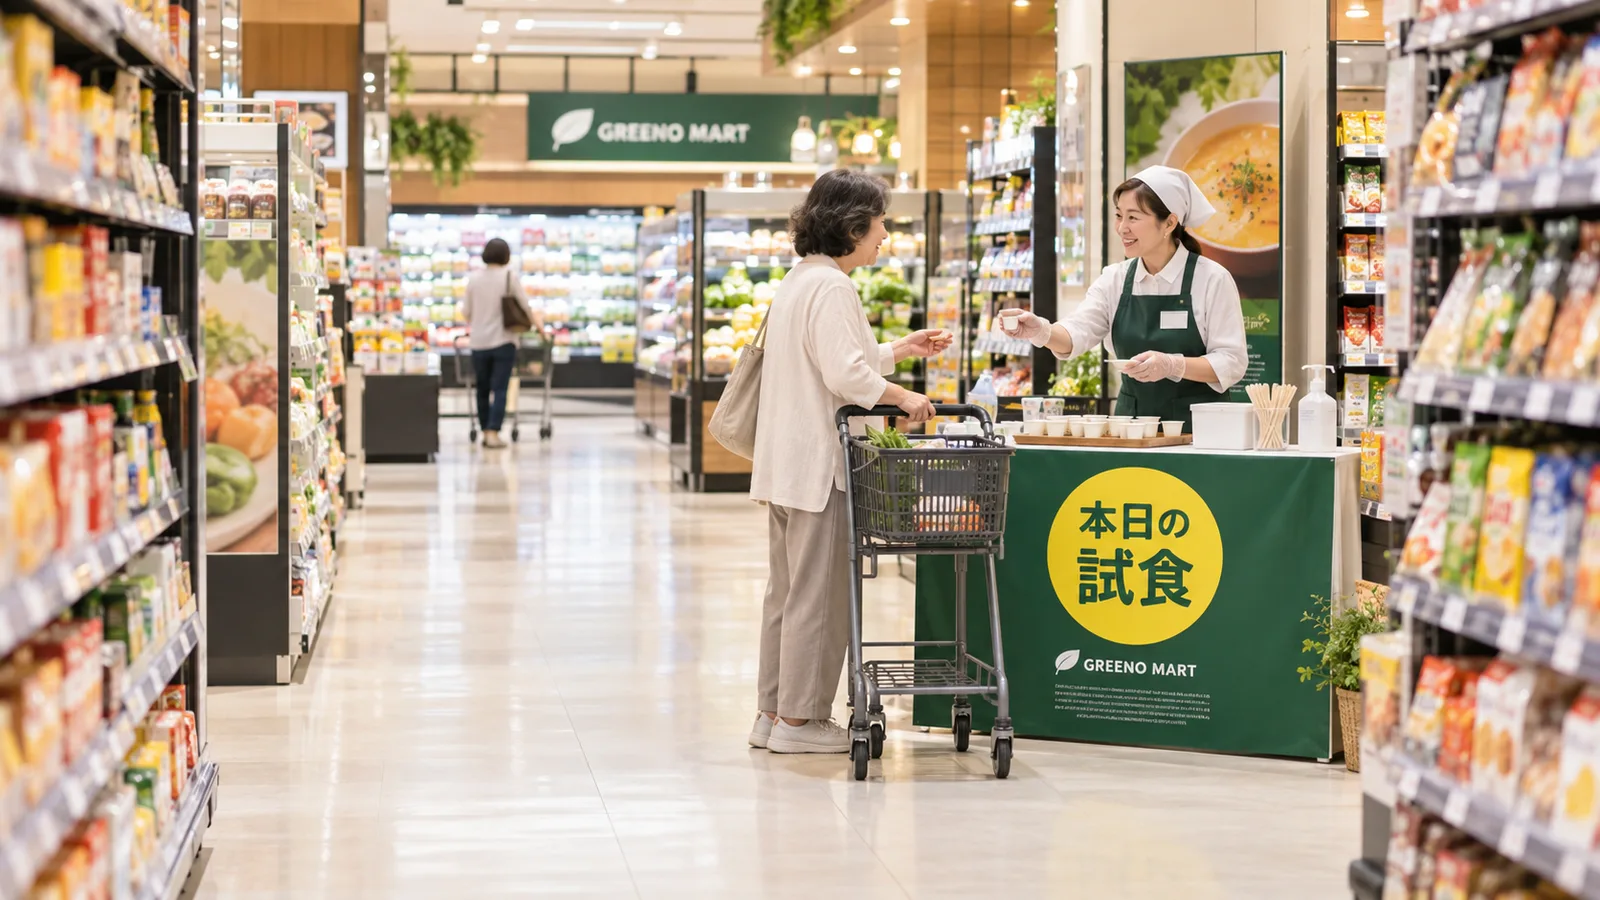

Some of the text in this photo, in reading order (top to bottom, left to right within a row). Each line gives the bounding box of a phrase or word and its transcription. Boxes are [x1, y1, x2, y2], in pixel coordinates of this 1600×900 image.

[597, 122, 750, 143] GREENO MART
[1079, 500, 1190, 540] 本日の
[1077, 548, 1193, 607] 試食
[1083, 658, 1197, 678] GREENO MART
